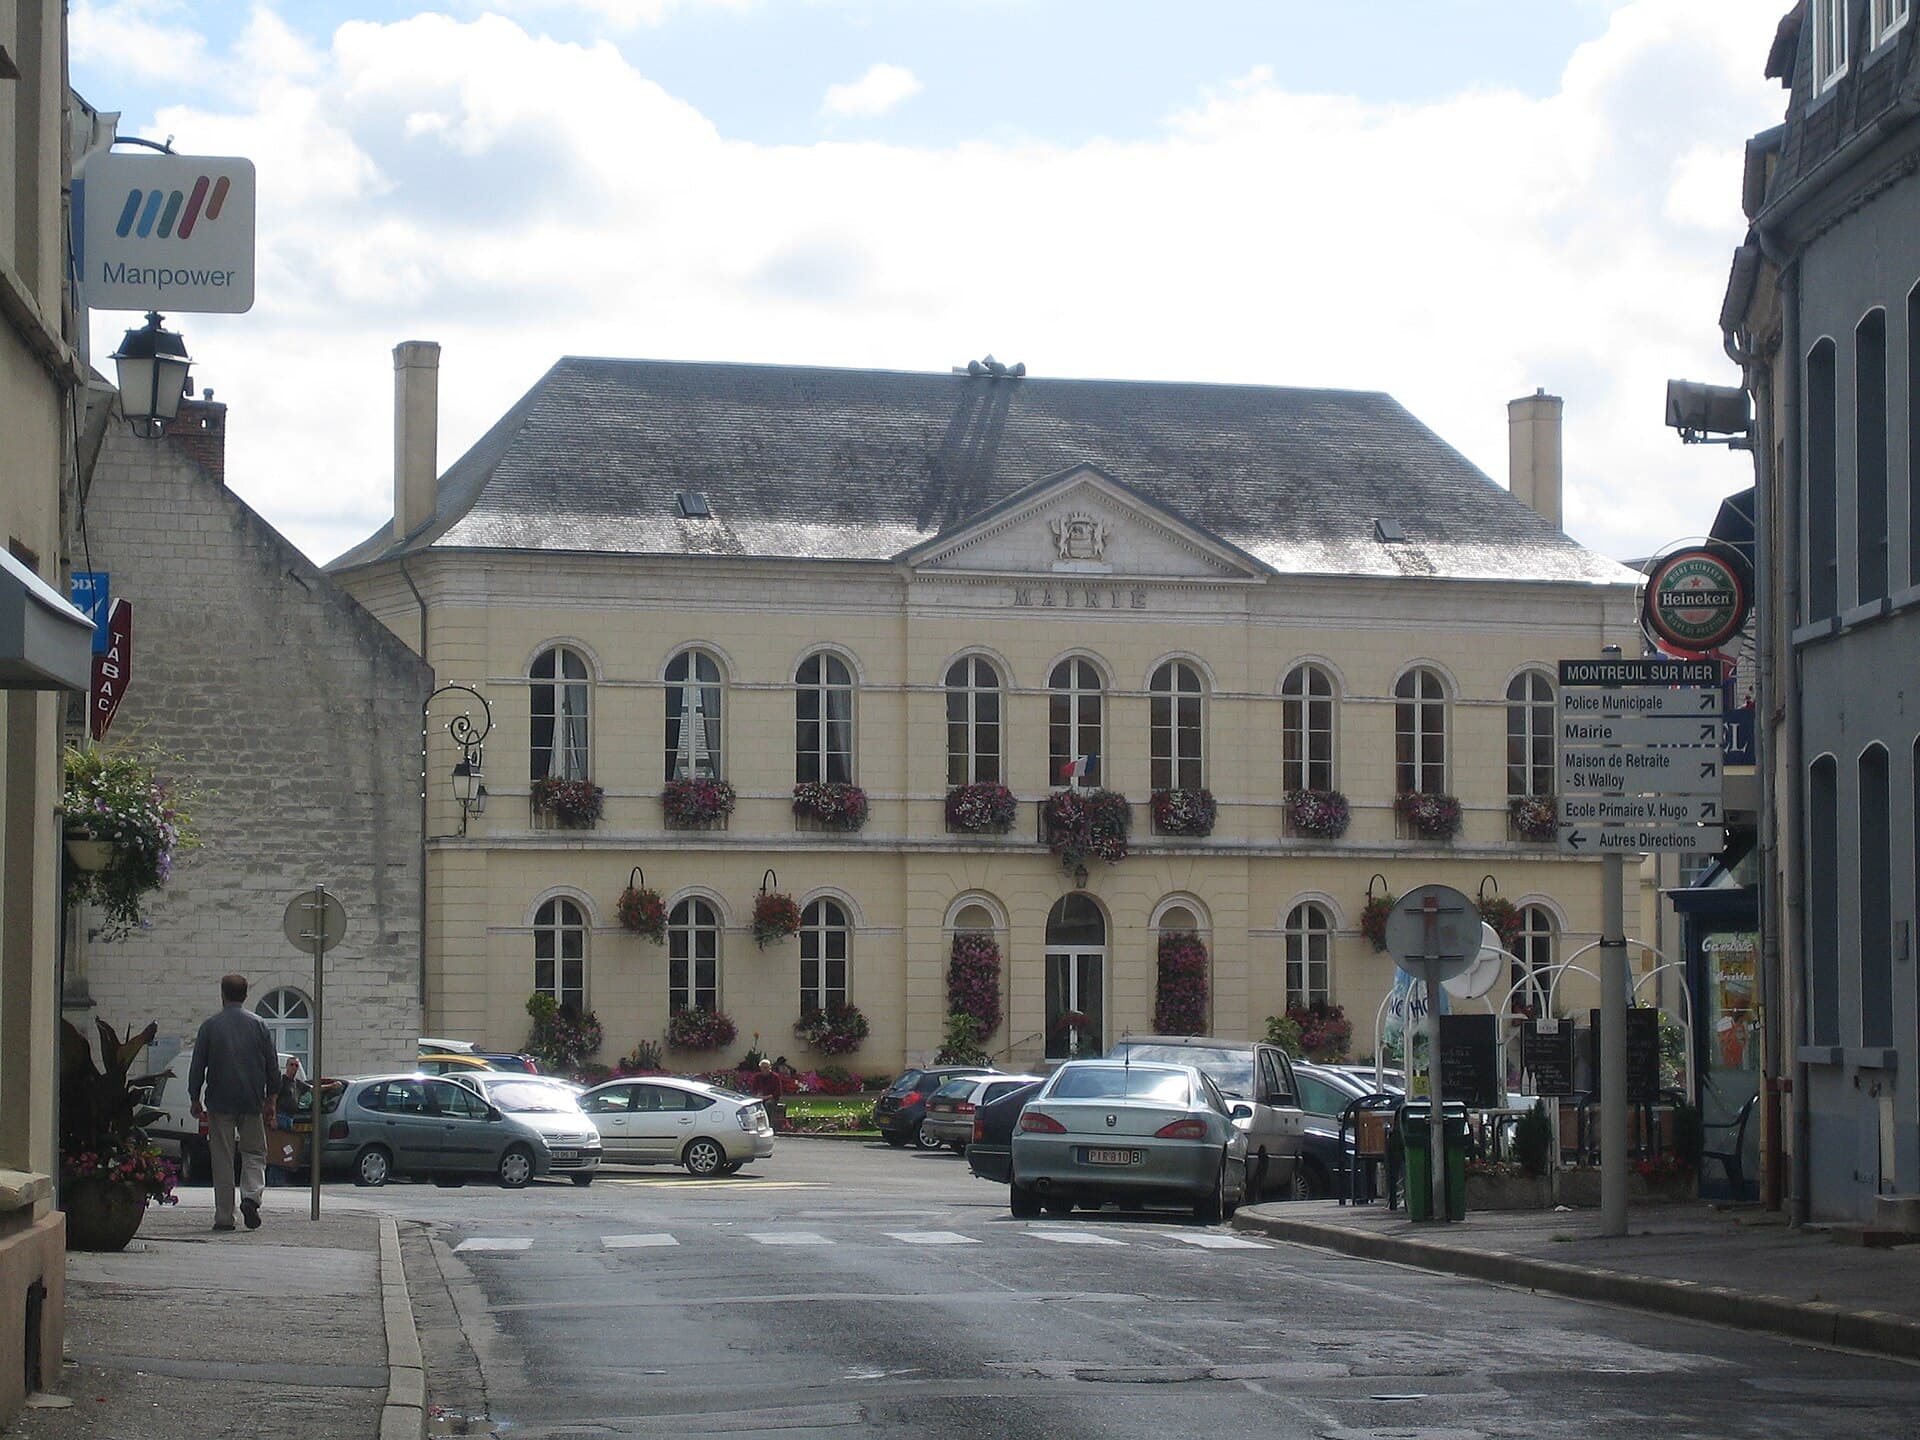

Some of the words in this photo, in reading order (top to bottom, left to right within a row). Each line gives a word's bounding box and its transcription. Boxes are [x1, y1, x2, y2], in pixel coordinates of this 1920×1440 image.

[103, 262, 235, 290] Manpower
[1014, 586, 1146, 609] MAIRIE
[1662, 593, 1730, 606] Heineken
[98, 632, 123, 711] TABAC
[1567, 665, 1646, 680] MONTREUIL
[1651, 665, 1679, 680] SUR
[1683, 665, 1713, 680] MER
[1565, 695, 1599, 710] Police
[1602, 695, 1663, 714] Municipale
[1566, 724, 1613, 739] Mairie
[1566, 754, 1606, 768] Maison
[1608, 754, 1622, 768] de
[1626, 754, 1670, 768] Retraite
[1573, 774, 1585, 787] St
[1588, 774, 1625, 790] Walloy
[1566, 803, 1596, 817] Ecole
[1599, 803, 1644, 817] Primaire
[1647, 803, 1656, 817] V.
[1659, 803, 1688, 820] Hugo
[1599, 833, 1636, 847] Autres
[1639, 832, 1696, 847] Directions
